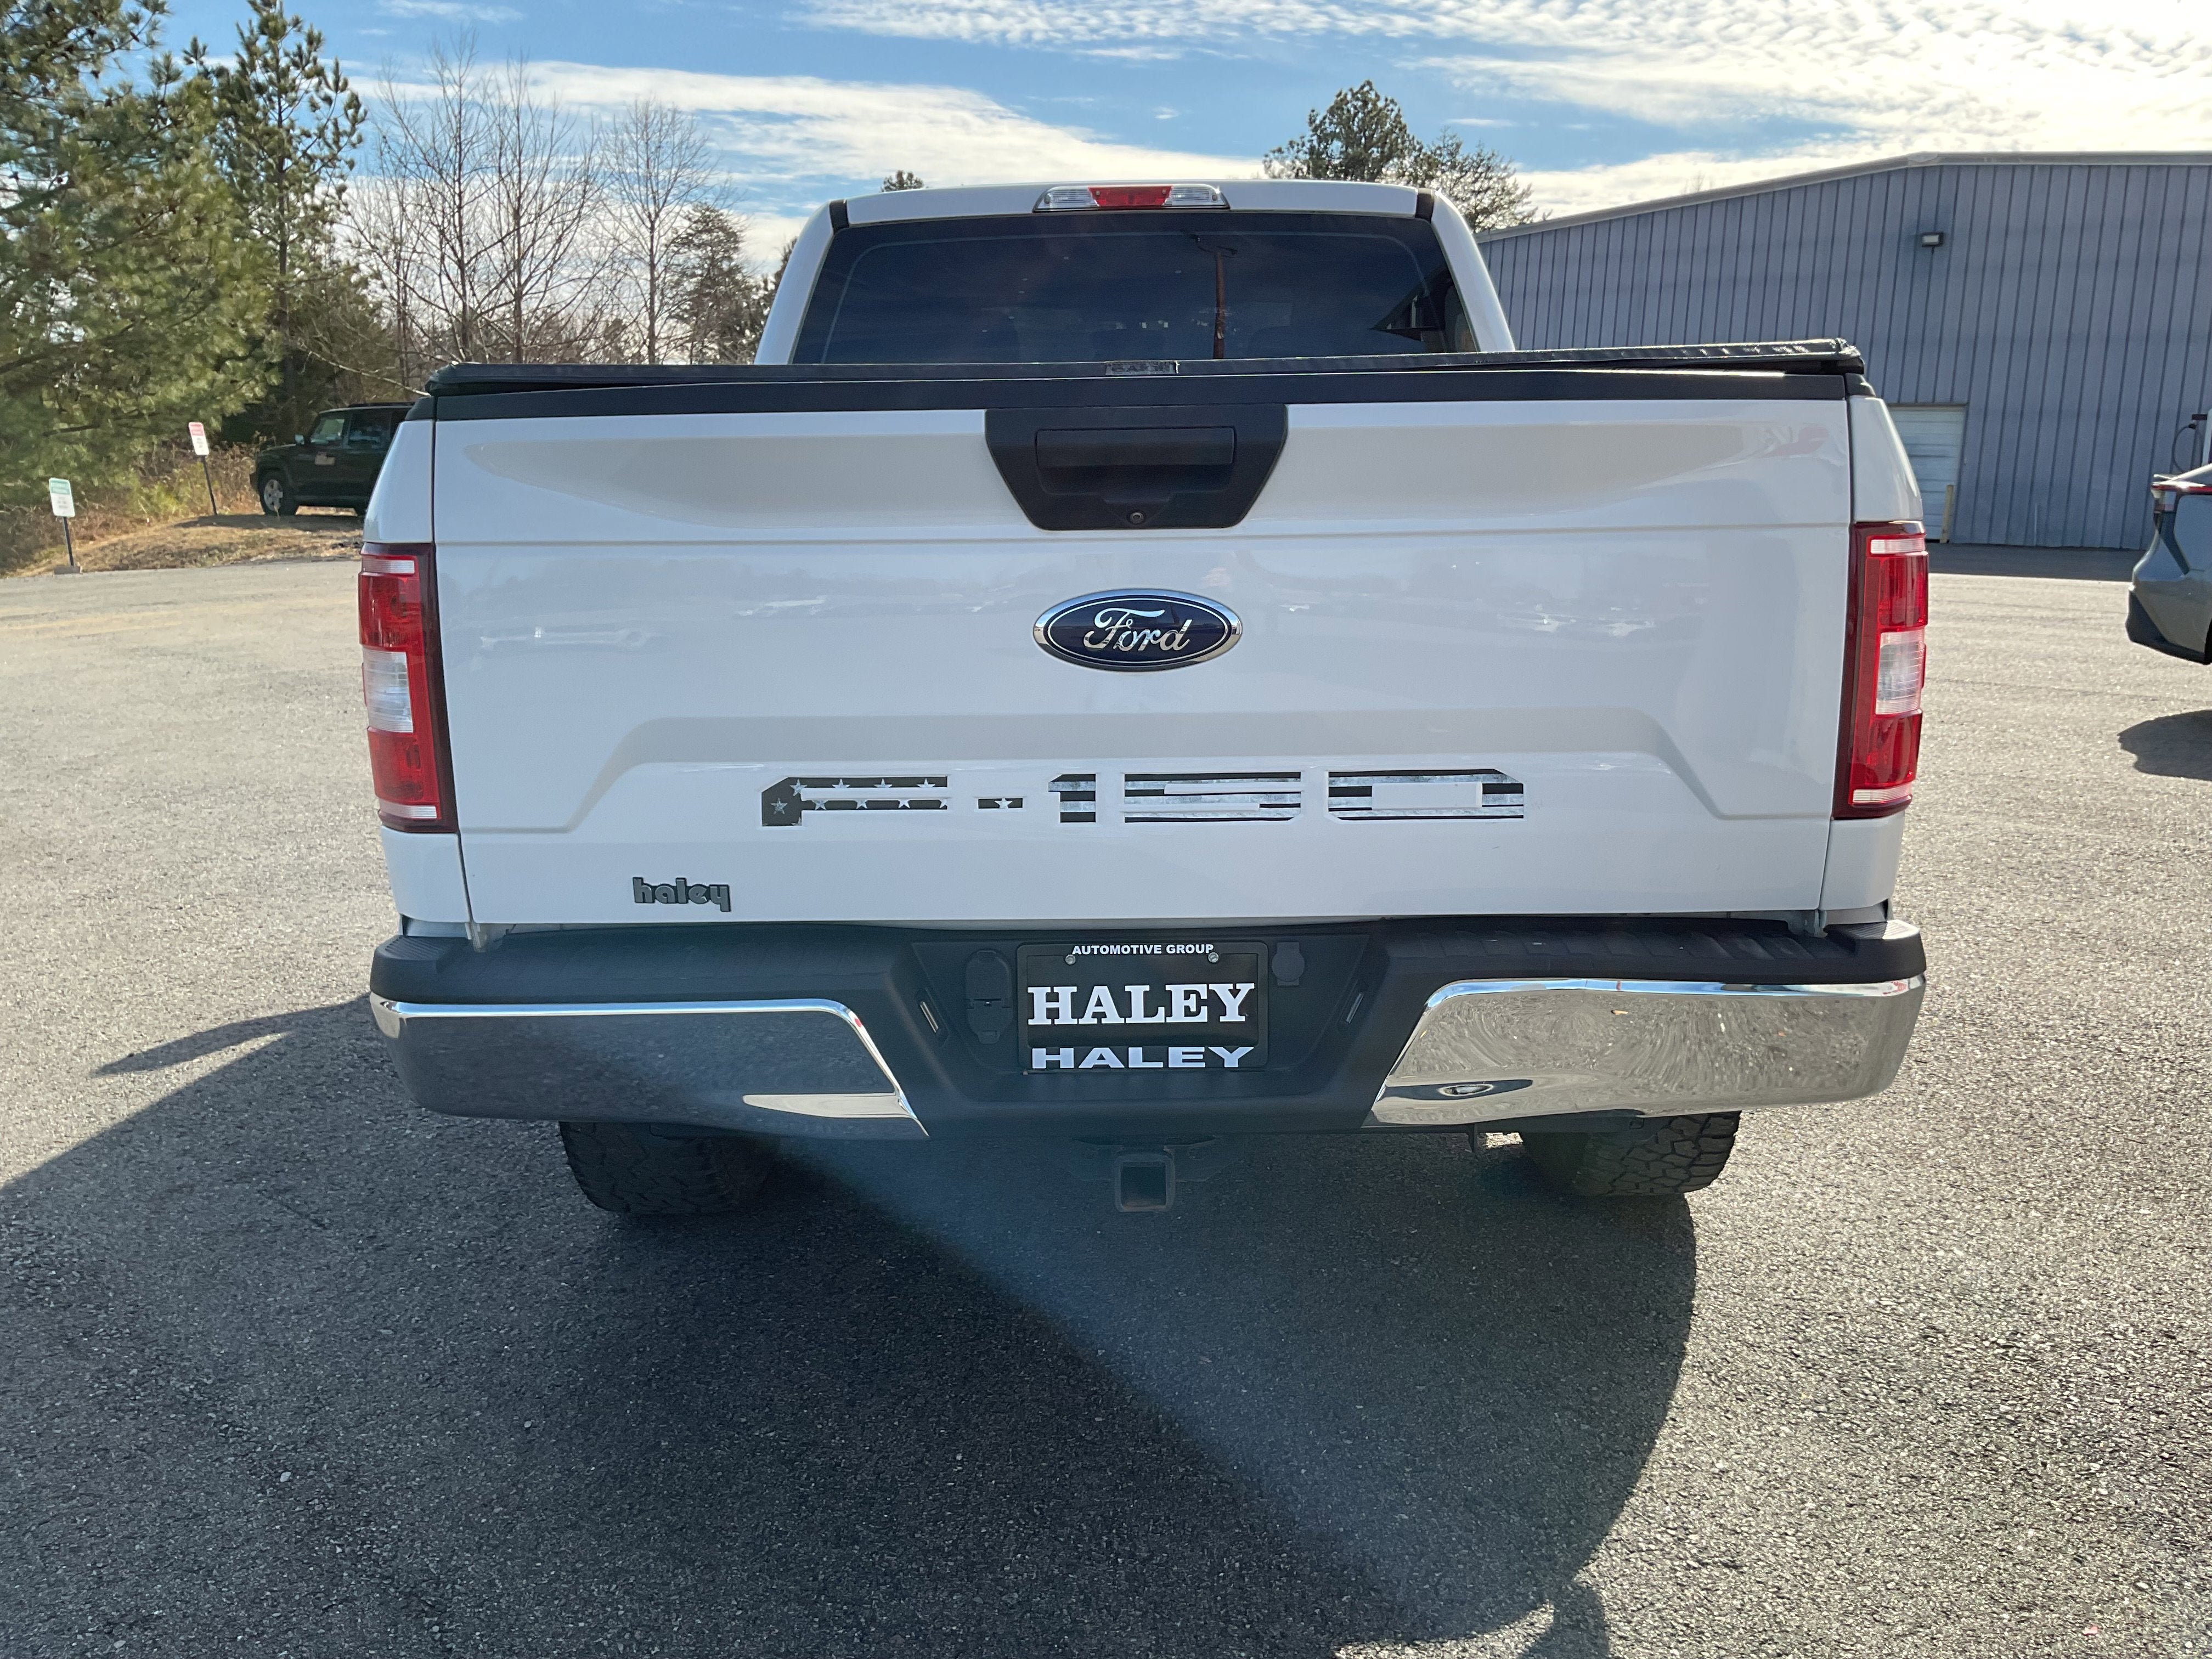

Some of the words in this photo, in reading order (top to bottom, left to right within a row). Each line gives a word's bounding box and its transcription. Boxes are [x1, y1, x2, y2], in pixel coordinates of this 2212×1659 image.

[1083, 607, 1193, 652] Ford
[761, 769, 1524, 826] F-150
[633, 877, 731, 912] haley
[1072, 945, 1162, 955] AUTOMOTIVE
[1166, 944, 1214, 954] GROUP
[1028, 983, 1255, 1025] HALEY
[1032, 1047, 1254, 1069] HALEY
